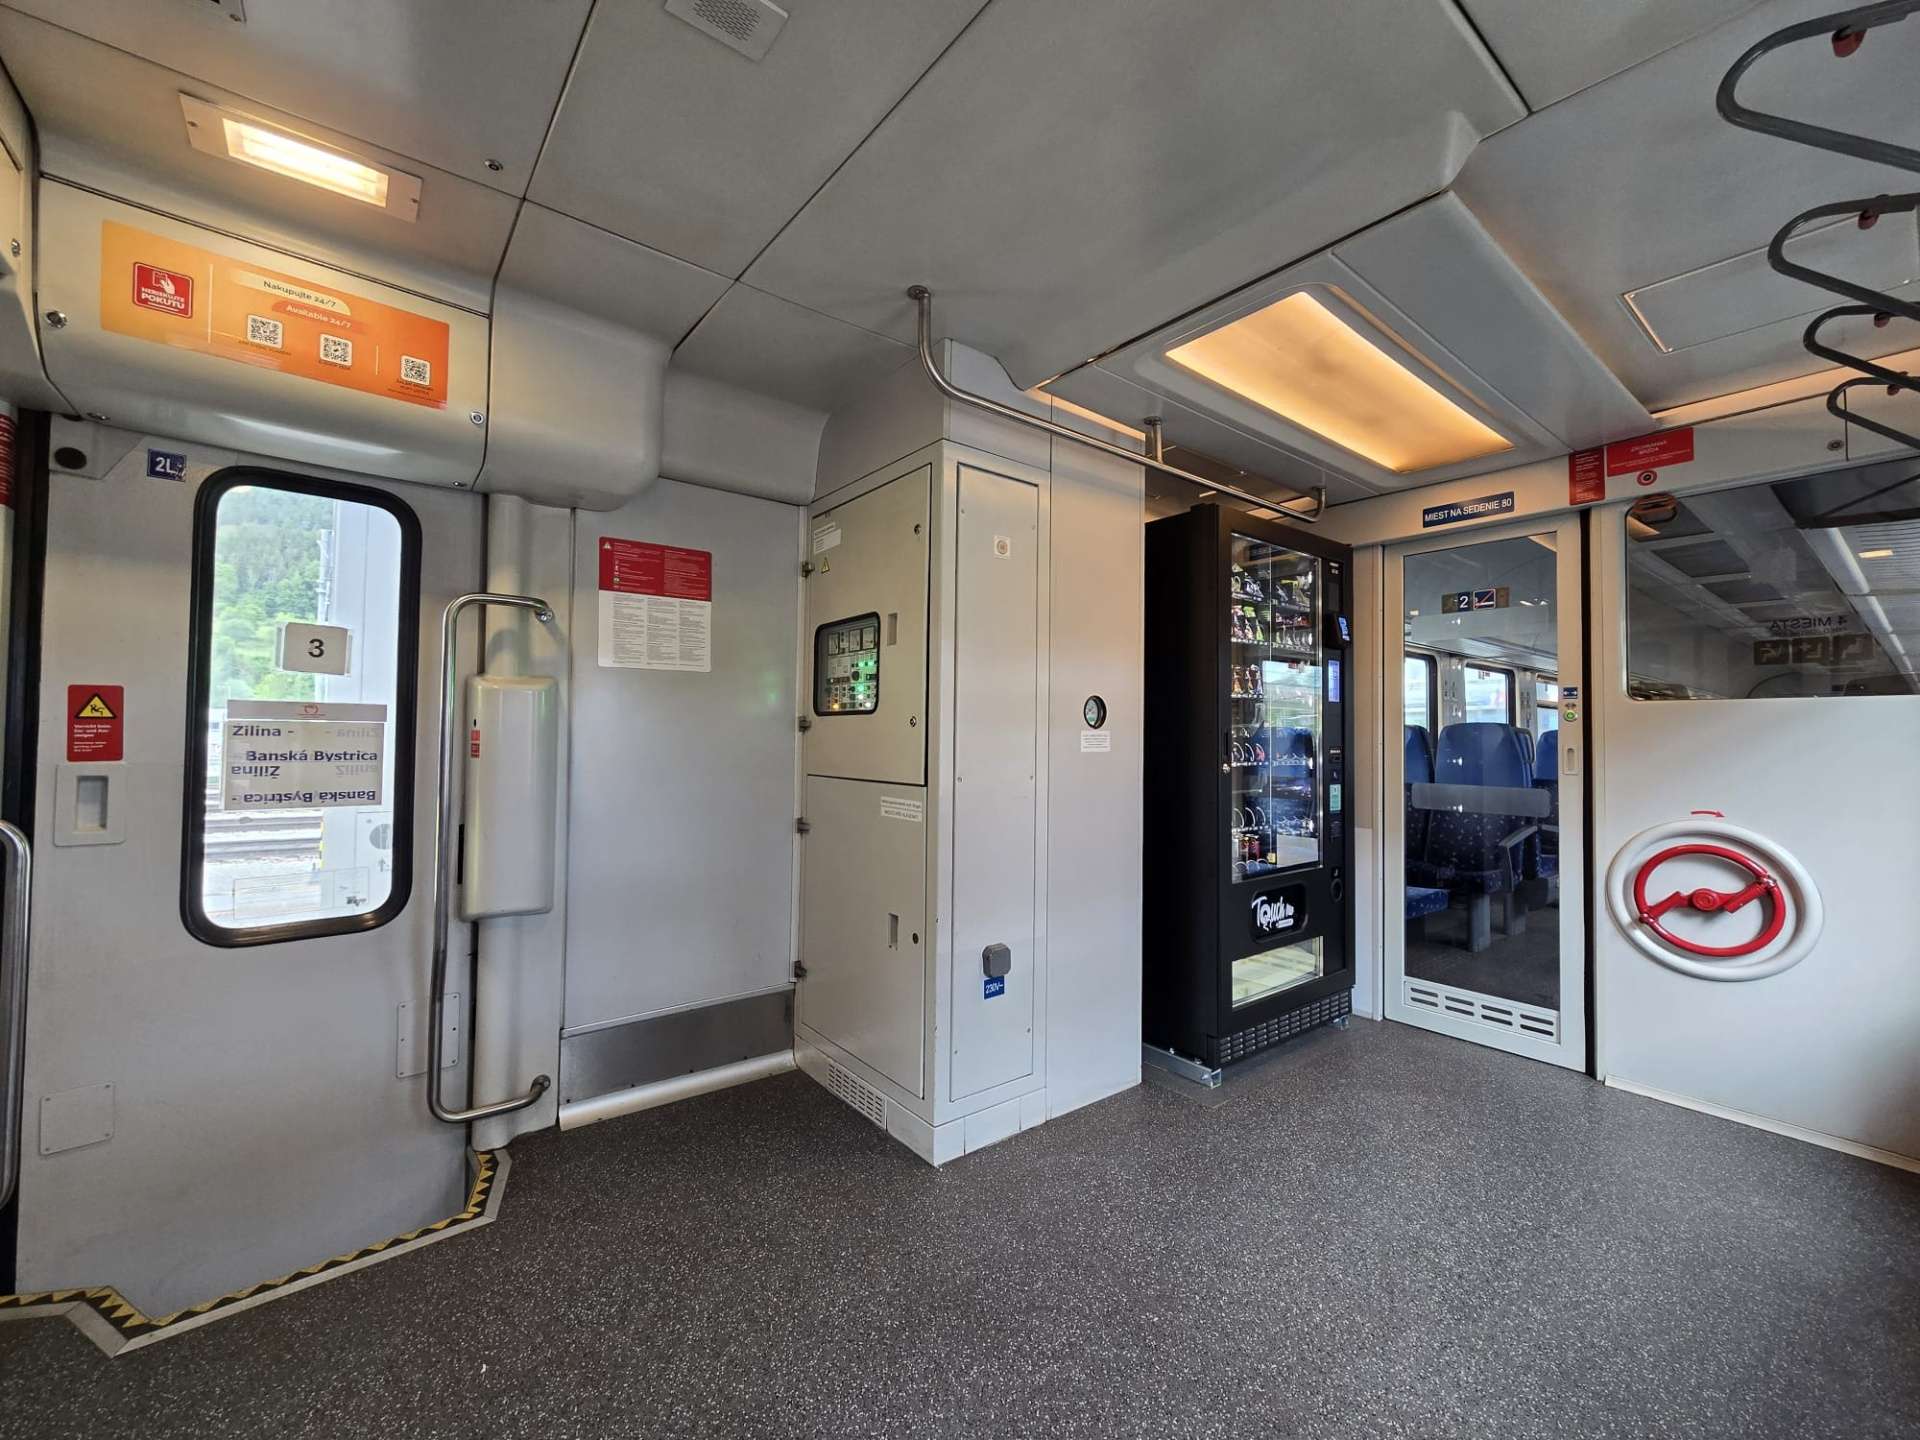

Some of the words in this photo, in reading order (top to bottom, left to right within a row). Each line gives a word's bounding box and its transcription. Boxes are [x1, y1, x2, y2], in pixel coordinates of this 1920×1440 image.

[141, 293, 185, 309] POKUTU
[263, 280, 312, 300] Nakupujte
[314, 295, 337, 307] 24/7
[1424, 510, 1449, 522] MIEST
[1450, 508, 1462, 517] NA
[1463, 500, 1500, 515] SEDENIE
[1459, 596, 1469, 608] 2
[308, 638, 325, 659] 3
[246, 749, 308, 762] Banská
[314, 750, 378, 763] Bystrica
[231, 765, 281, 780] Žilina
[243, 790, 313, 805] Bystrica
[319, 790, 376, 804] Banská
